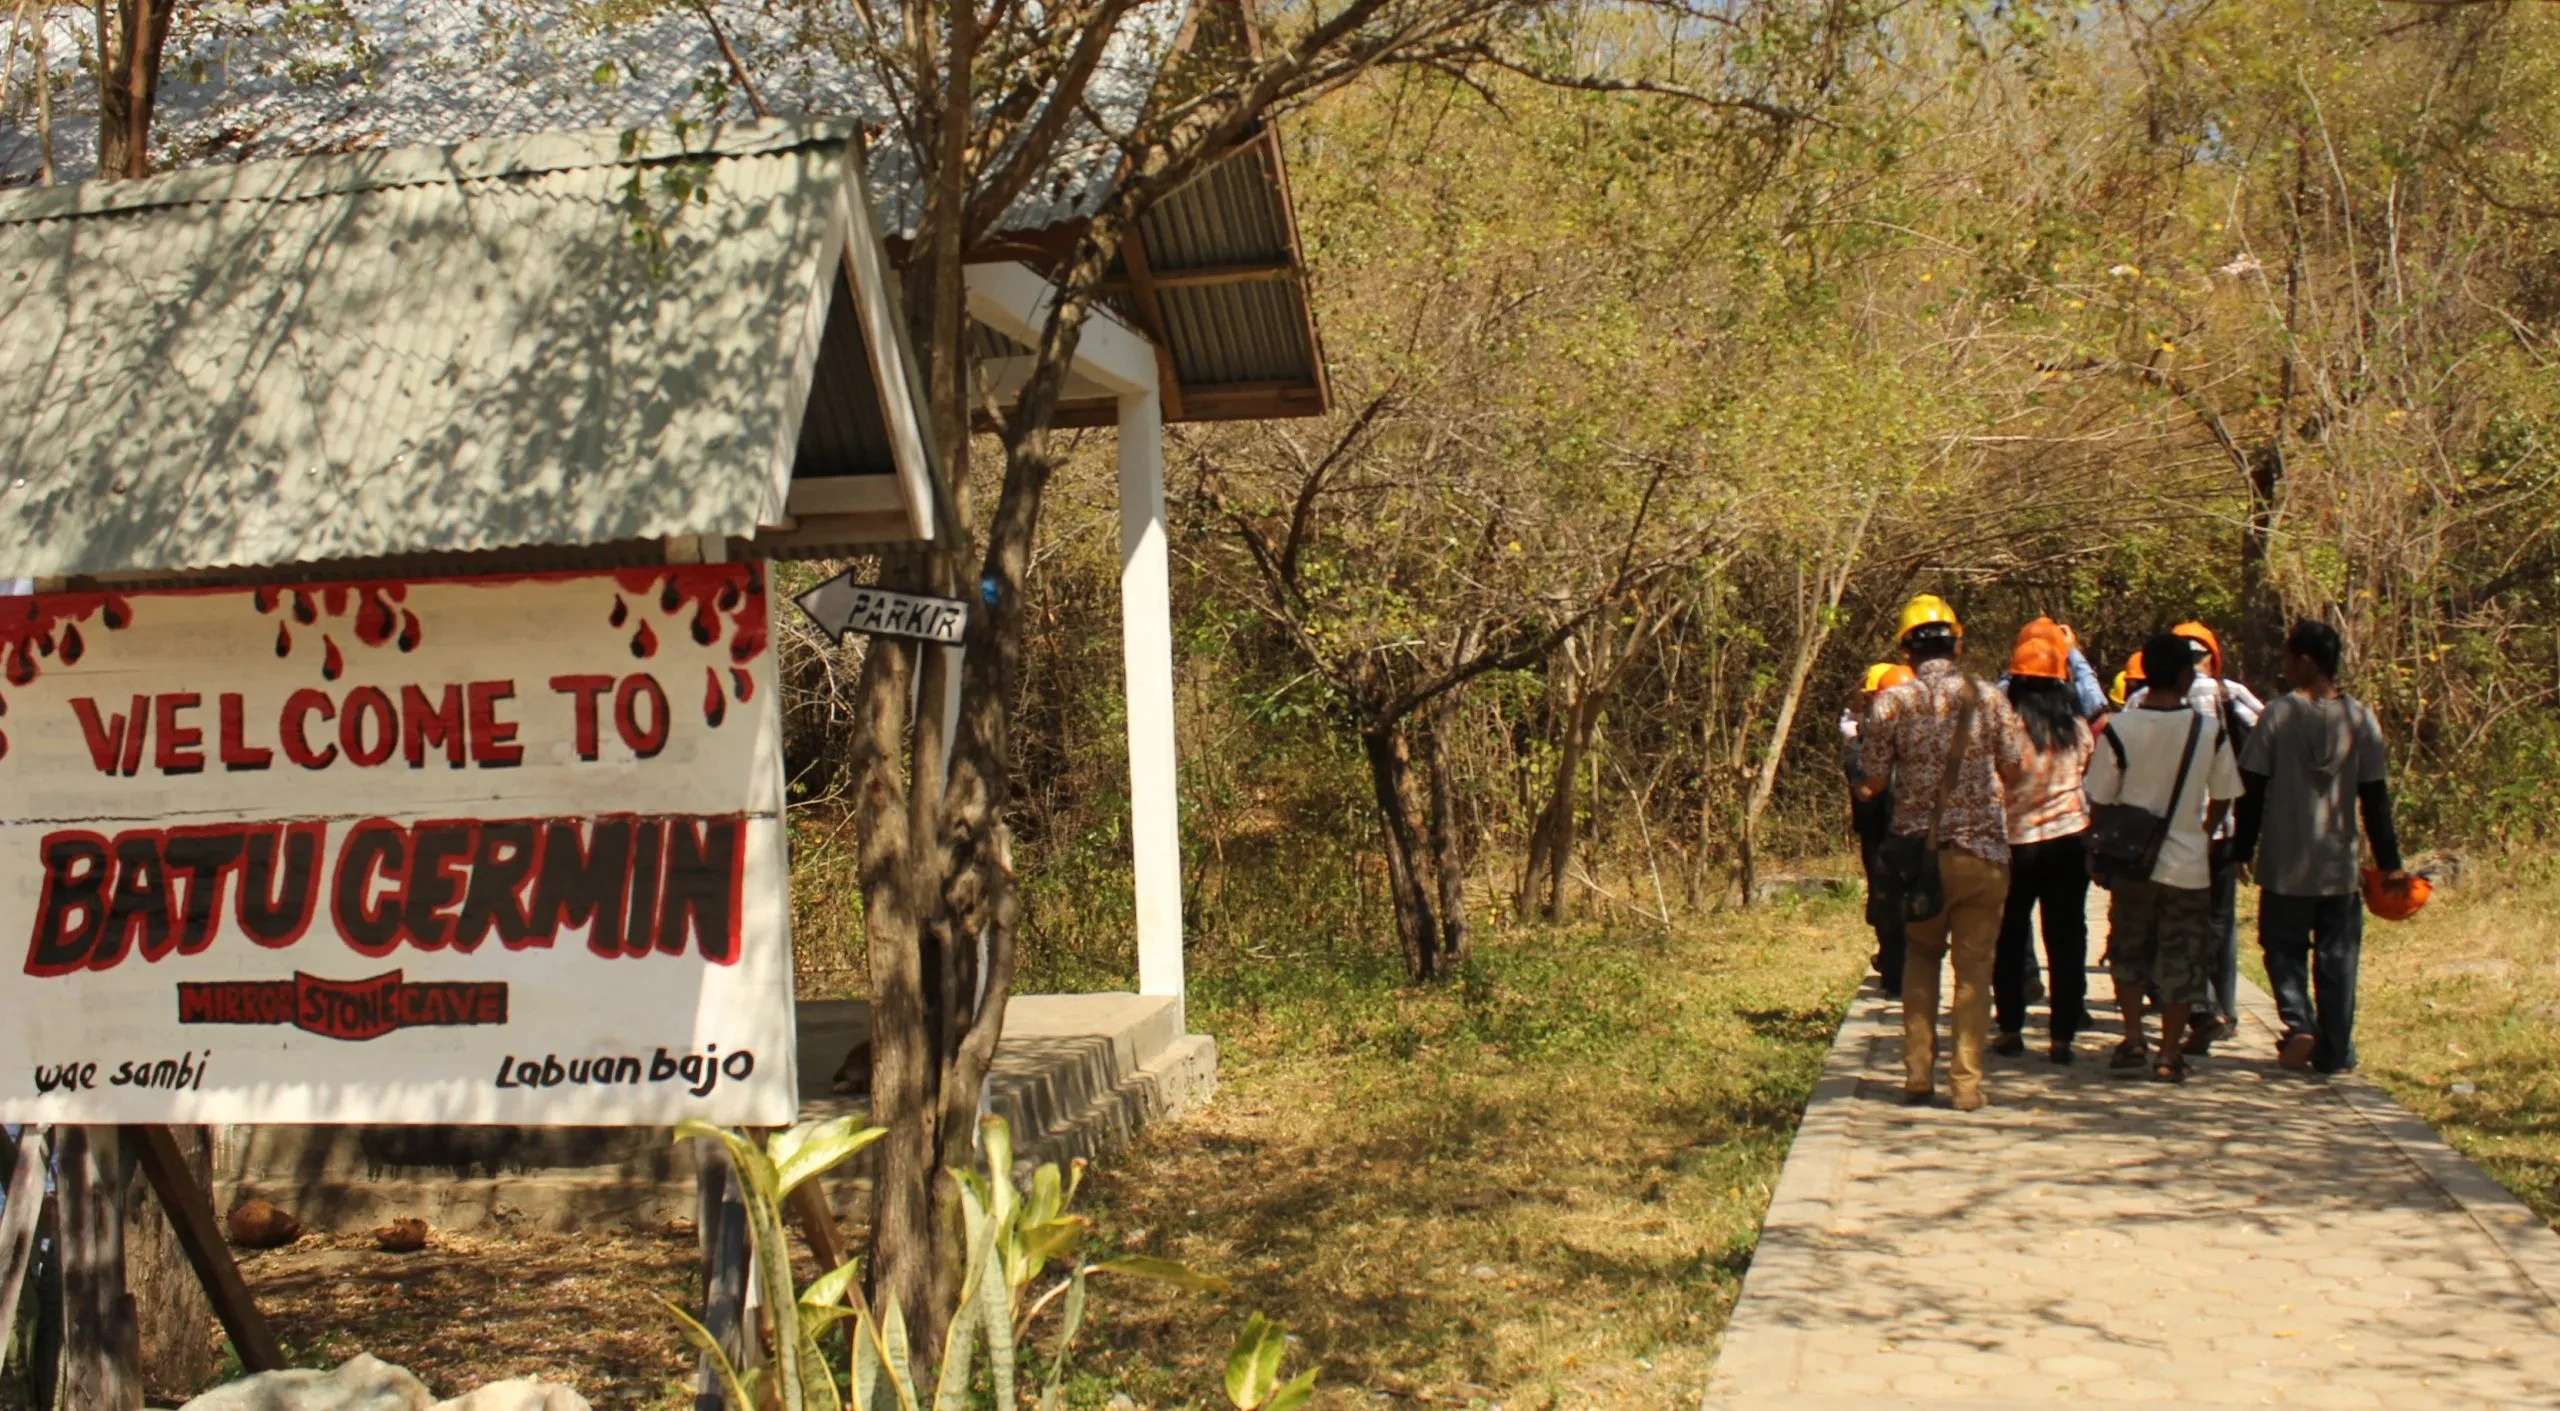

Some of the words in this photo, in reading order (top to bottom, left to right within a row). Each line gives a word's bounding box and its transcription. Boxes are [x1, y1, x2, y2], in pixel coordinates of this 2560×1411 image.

[849, 594, 960, 638] PARKIR
[68, 679, 524, 777] WELCOME
[549, 672, 671, 762] TO
[24, 819, 327, 976] BATU
[330, 812, 746, 966] CERMIN
[180, 985, 296, 1023] MIRROR
[304, 983, 397, 1031] STONE
[401, 985, 499, 1023] CAVE
[35, 1061, 98, 1097] wae
[109, 1049, 212, 1091] sambi
